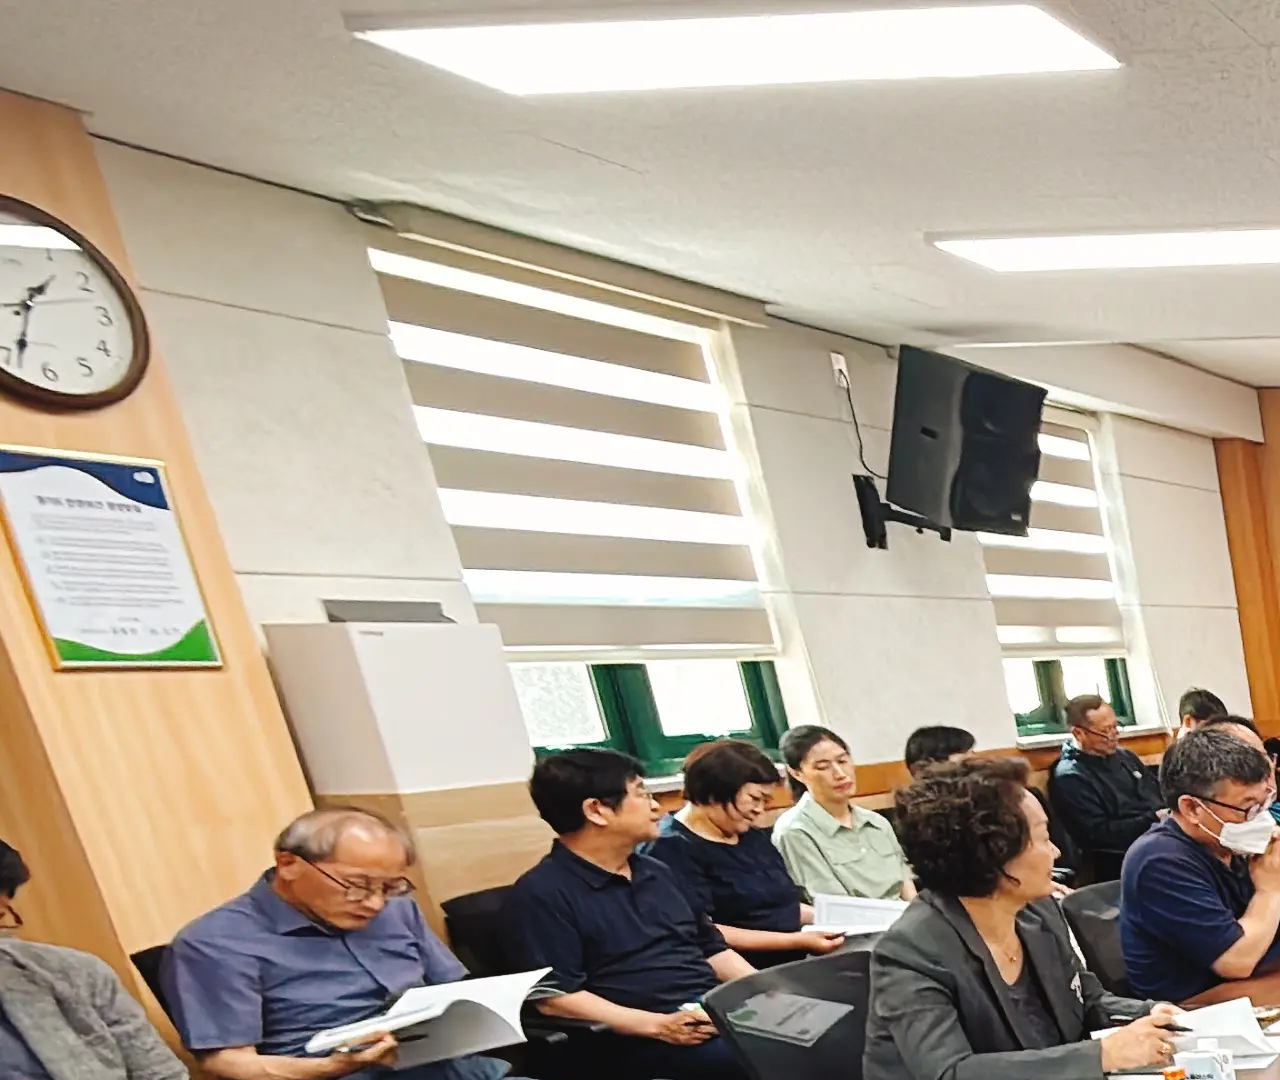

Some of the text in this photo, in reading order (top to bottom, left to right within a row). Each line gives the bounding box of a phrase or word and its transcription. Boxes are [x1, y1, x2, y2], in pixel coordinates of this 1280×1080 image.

[76, 271, 95, 293] 2
[95, 306, 113, 327] 3
[96, 339, 111, 357] 4
[41, 361, 59, 383] 6
[76, 356, 94, 377] 5
